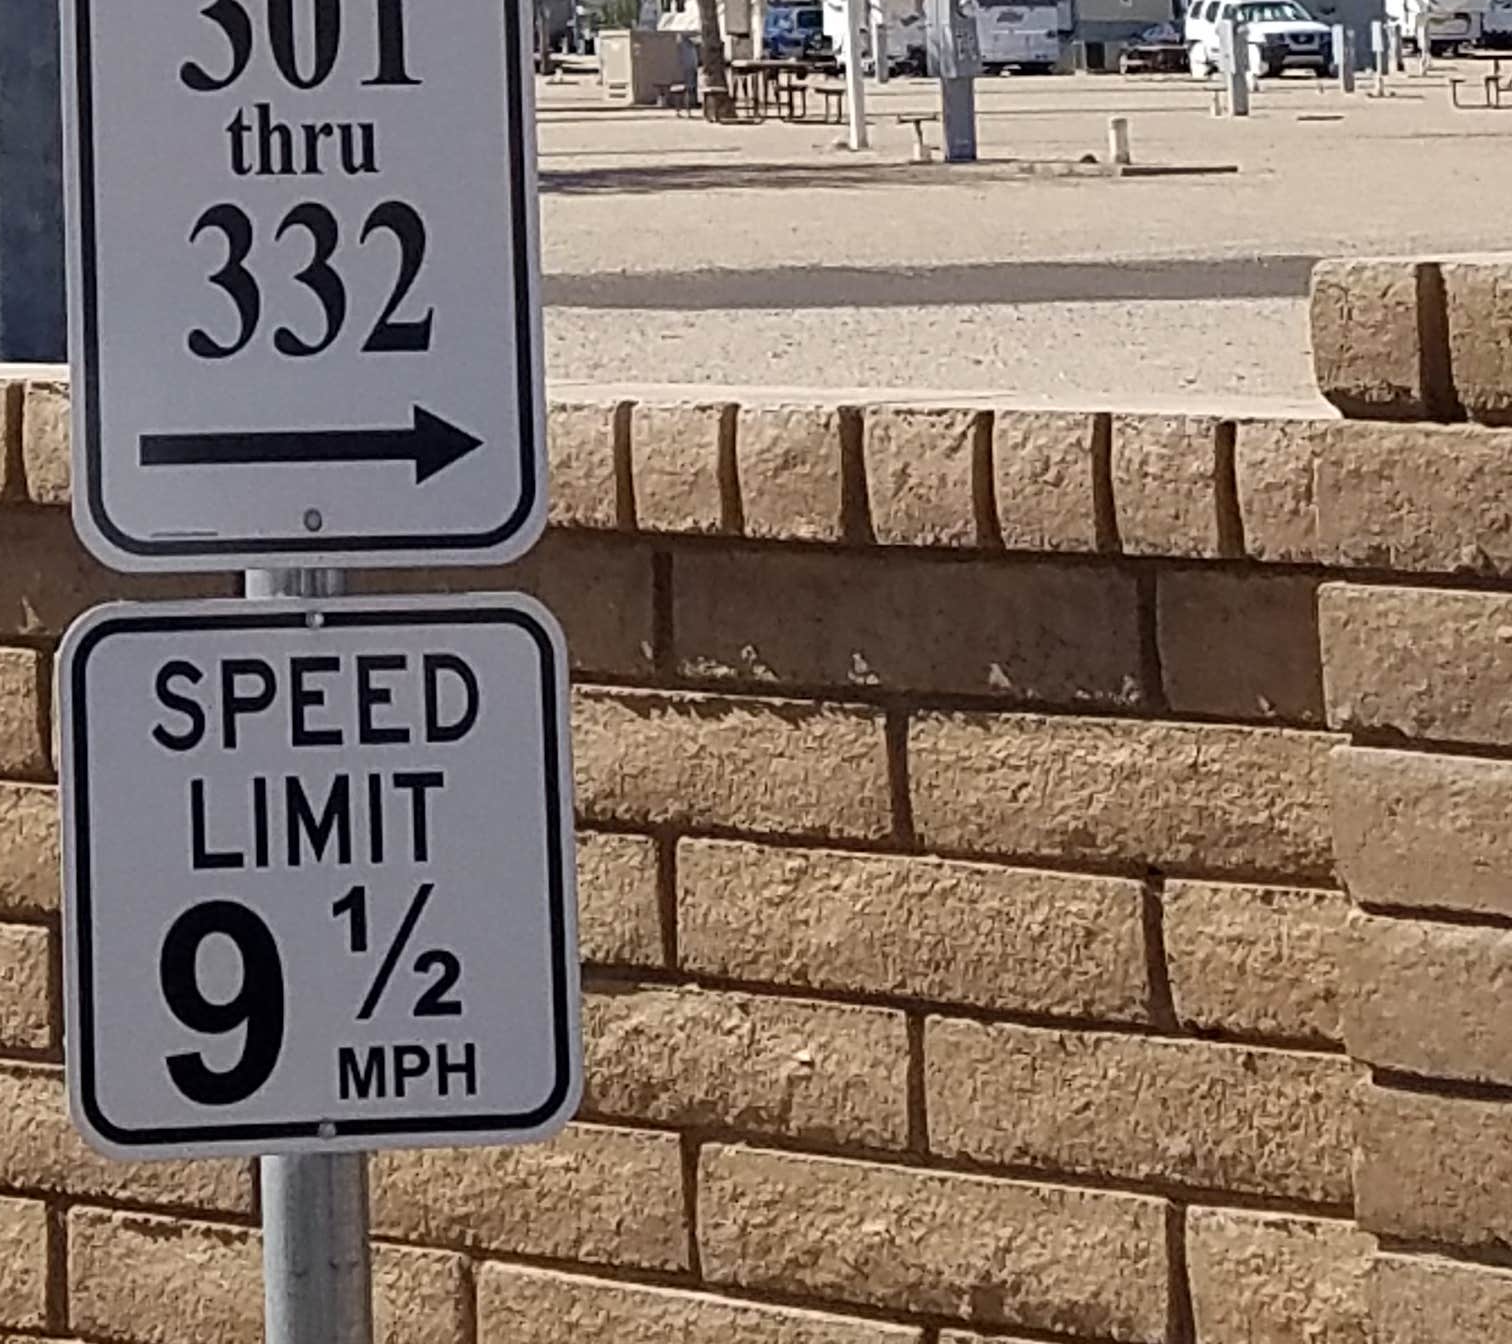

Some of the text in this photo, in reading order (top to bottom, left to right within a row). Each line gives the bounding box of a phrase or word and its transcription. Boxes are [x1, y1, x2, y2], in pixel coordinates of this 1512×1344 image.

[225, 103, 380, 176] thru
[187, 200, 434, 359] 332
[151, 653, 480, 751] SPEED
[190, 771, 445, 870] LIMIT
[159, 899, 286, 1106] 9
[337, 1042, 478, 1100] MPH
